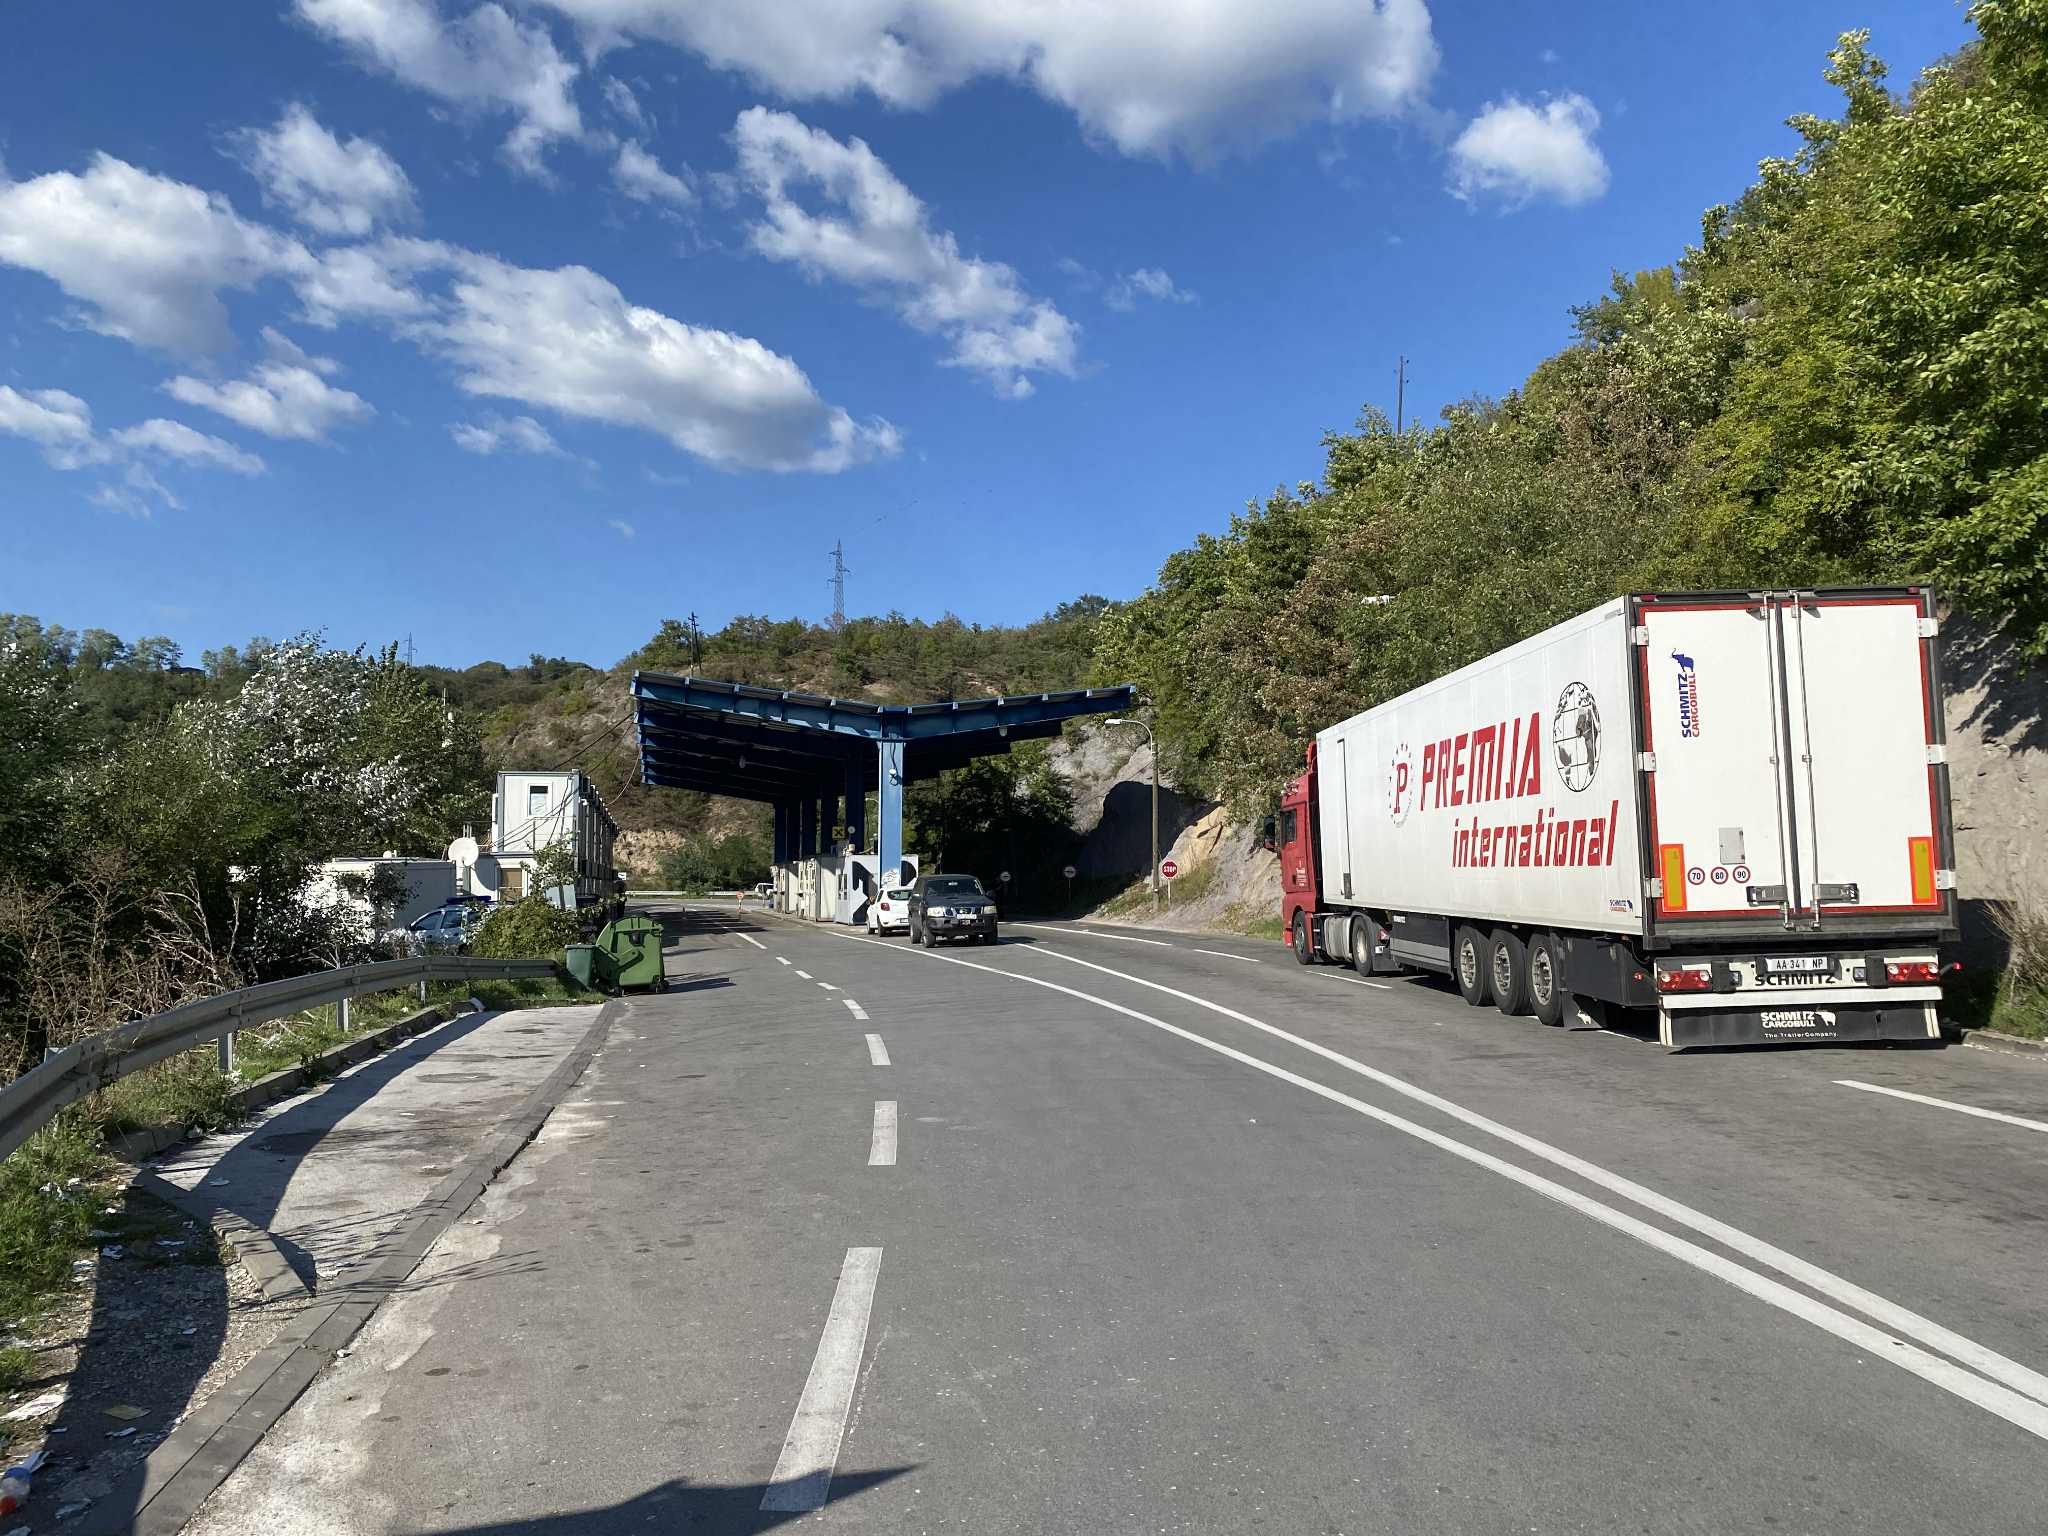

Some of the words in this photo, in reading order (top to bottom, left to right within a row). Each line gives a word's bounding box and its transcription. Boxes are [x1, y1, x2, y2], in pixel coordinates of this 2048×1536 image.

[1678, 673, 1692, 738] SCHMITZ
[1688, 672, 1700, 738] CARGOBULL
[1420, 711, 1541, 811] PREMIJA
[1393, 762, 1409, 814] P
[1452, 800, 1619, 868] international
[1692, 872, 1701, 880] 70
[1715, 872, 1724, 880] 80
[1737, 870, 1746, 879] 90
[1812, 958, 1823, 968] NP
[1755, 974, 1836, 986] SCHMITZ
[1760, 1011, 1815, 1022] SCHMITZ
[1762, 1020, 1816, 1029] CARGOBULL
